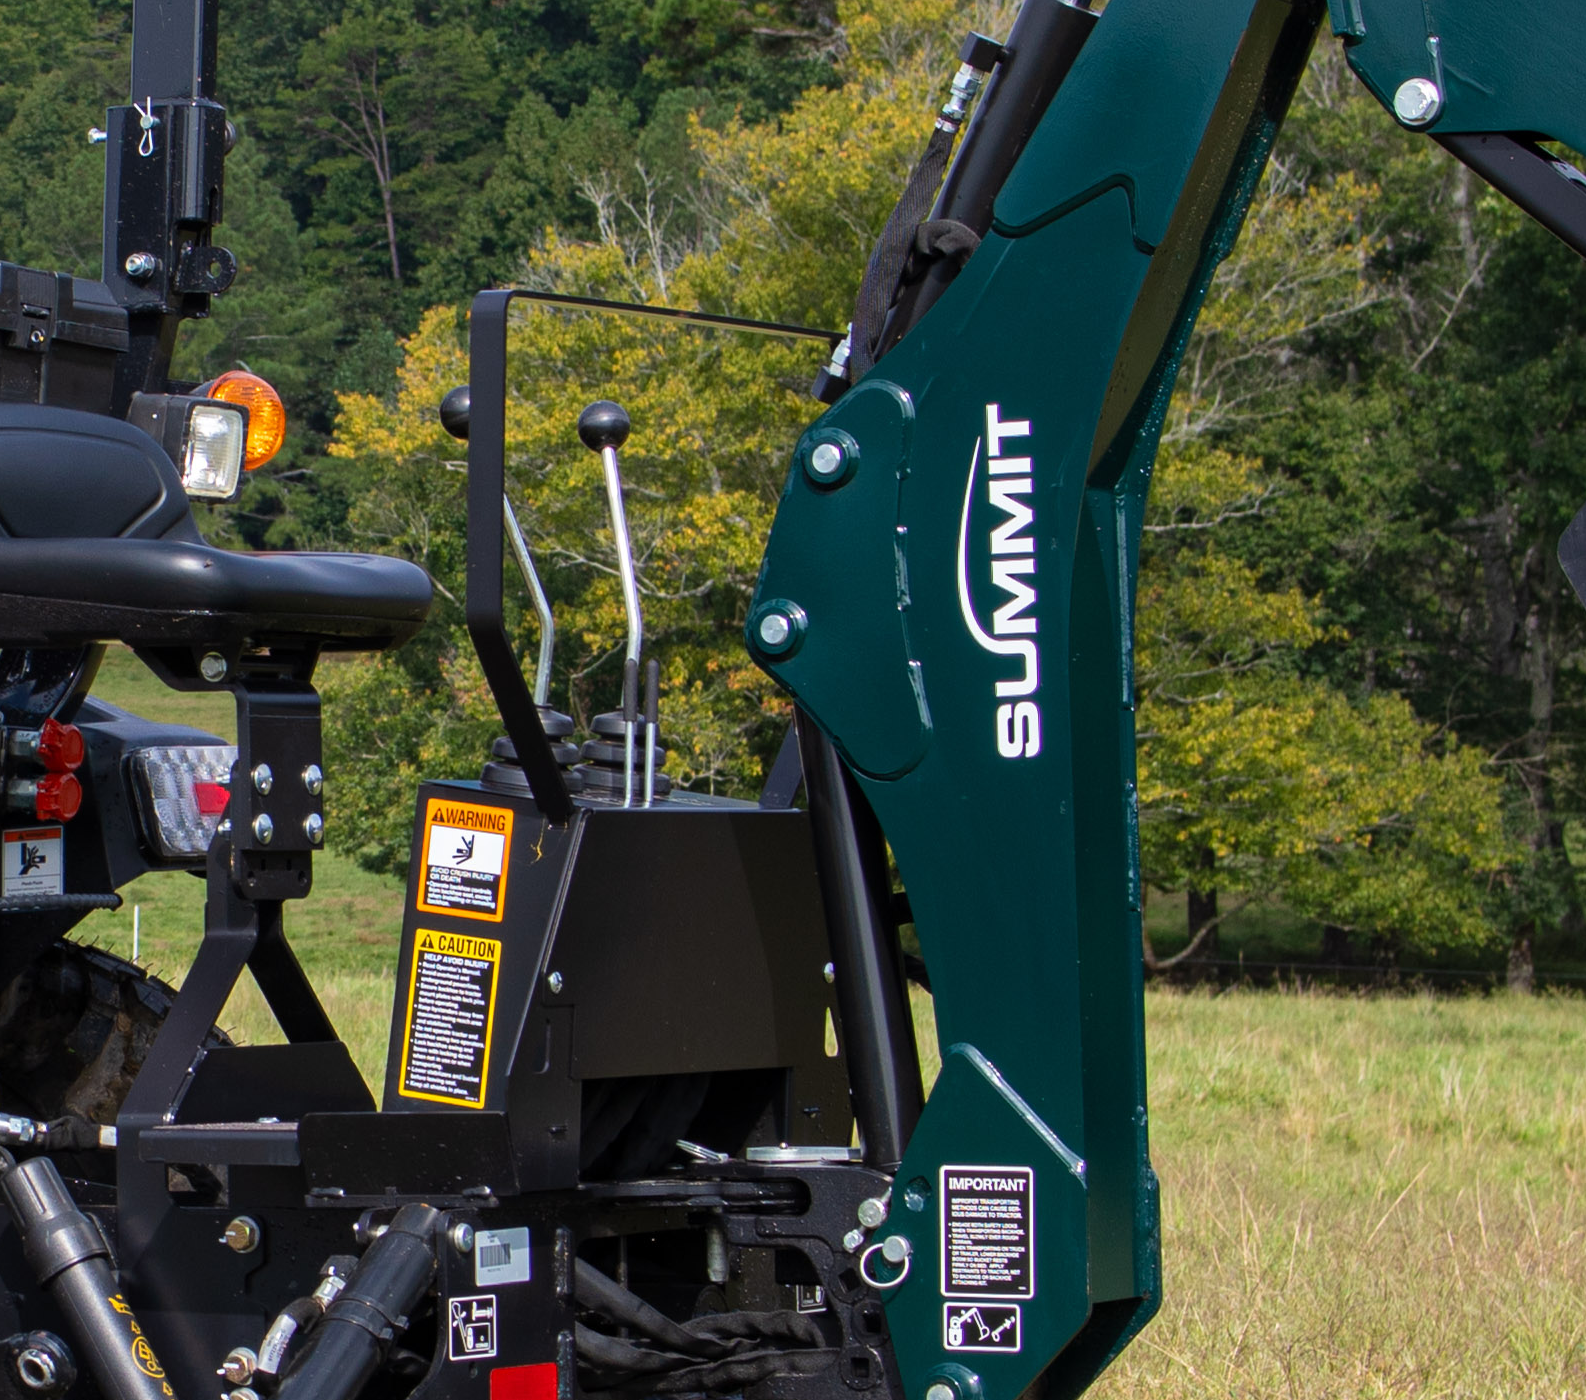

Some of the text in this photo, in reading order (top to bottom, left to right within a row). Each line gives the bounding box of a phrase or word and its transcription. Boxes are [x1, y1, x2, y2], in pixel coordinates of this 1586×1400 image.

[958, 403, 1040, 758] SUMMIT
[446, 806, 506, 831] WARNING
[431, 867, 494, 881] AVOID CRUSH INJURY
[440, 875, 461, 883] DEATH
[438, 935, 495, 958] CAUTION
[424, 954, 489, 969] HELP AVOID INJURY
[949, 1177, 1026, 1191] IMPORTANT
